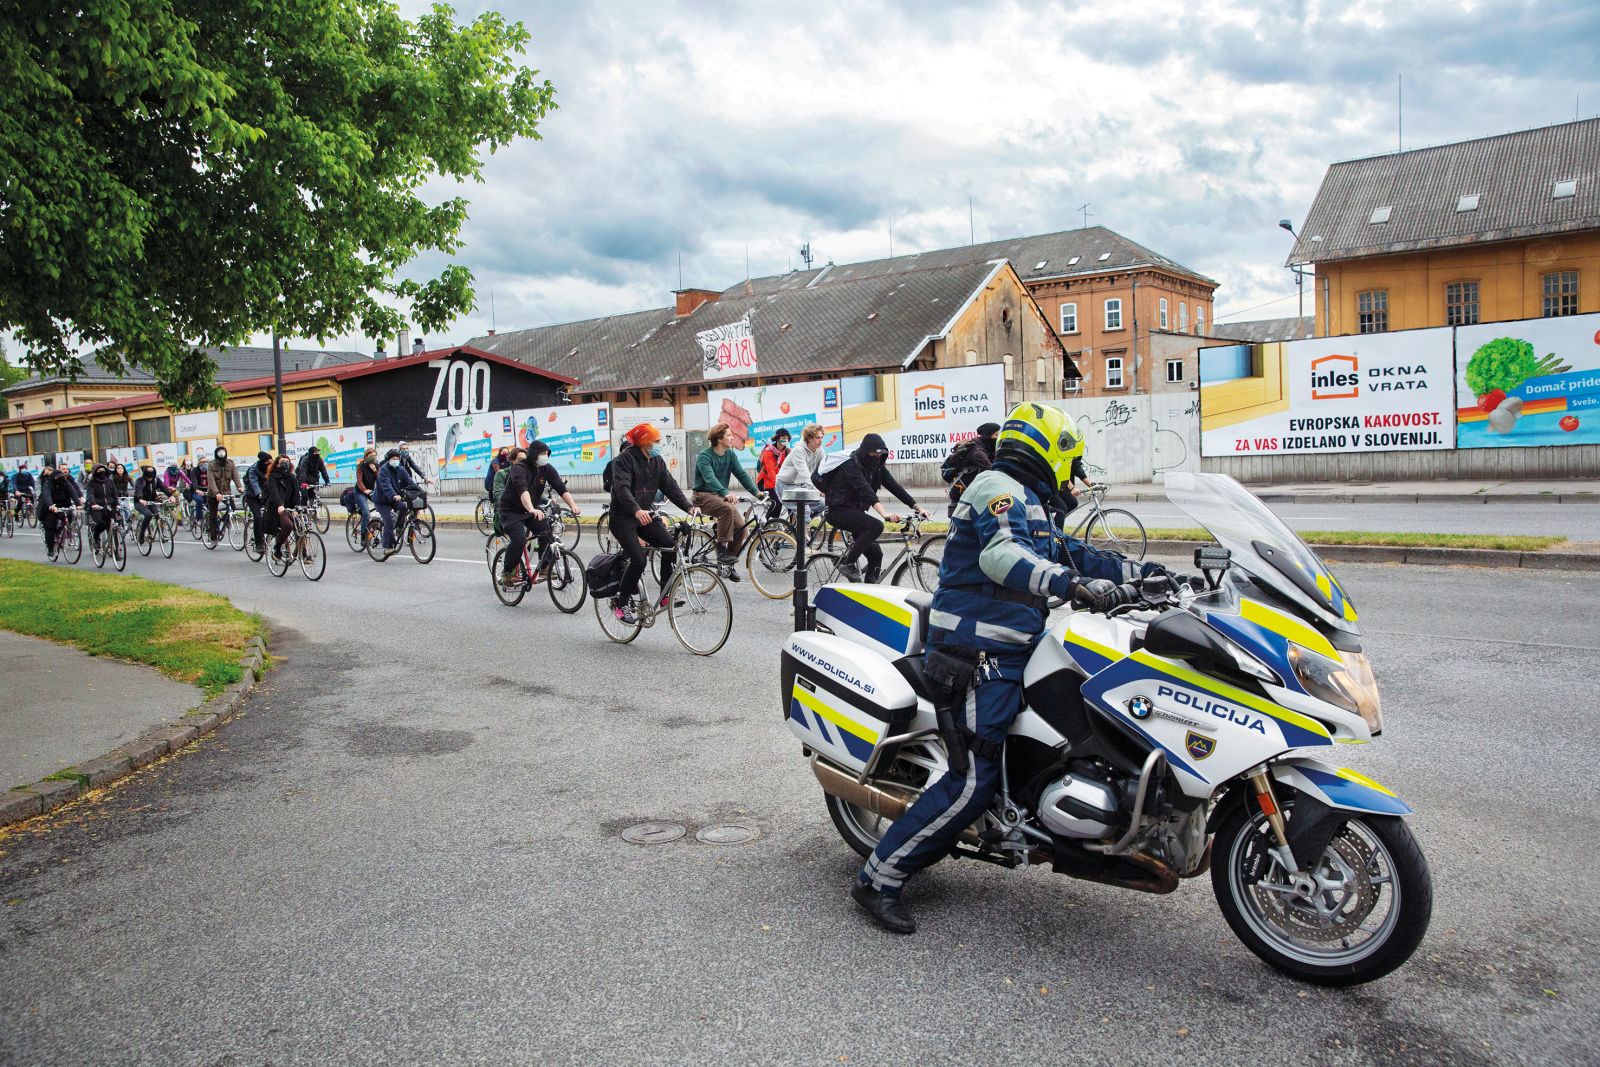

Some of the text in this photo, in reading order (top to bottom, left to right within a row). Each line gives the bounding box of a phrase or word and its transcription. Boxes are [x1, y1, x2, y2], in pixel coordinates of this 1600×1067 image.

[1369, 365, 1427, 377] OKNA
[1312, 371, 1359, 388] inles
[1369, 380, 1428, 392] VRATA
[427, 360, 491, 418] ZOO
[1525, 380, 1566, 394] Domač
[915, 397, 946, 411] inles
[951, 393, 989, 403] OKNA
[1572, 397, 1599, 407] Sveže.
[951, 405, 989, 414] VRATA
[1290, 412, 1442, 431] EVROPSKA KAKOVOST.
[901, 434, 947, 445] EVROPSKA
[1235, 431, 1442, 451] ZA VAS IZDELANO V SLOVENIJI.
[897, 448, 938, 460] IZDELANO
[941, 448, 947, 458] V
[792, 643, 875, 695] WWW.POLICIJA.SI
[1157, 685, 1266, 735] POLICIJA
[1250, 853, 1261, 877] brembo
